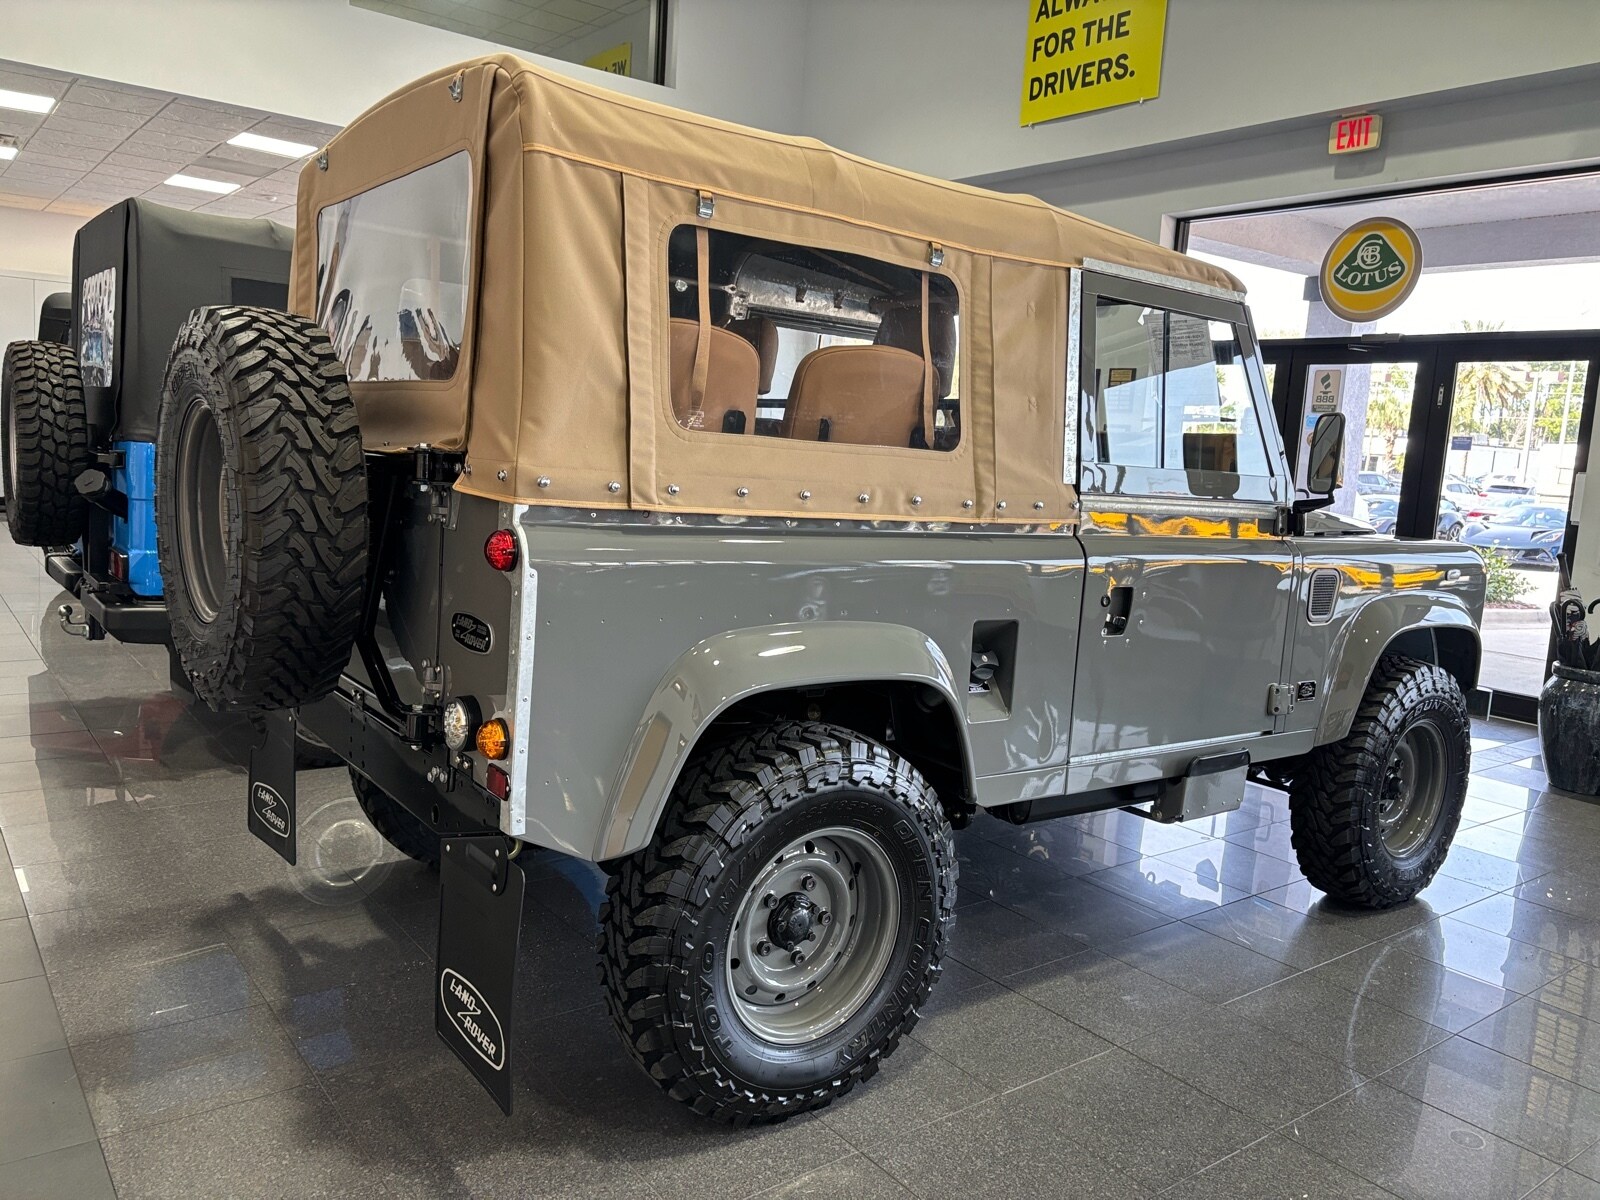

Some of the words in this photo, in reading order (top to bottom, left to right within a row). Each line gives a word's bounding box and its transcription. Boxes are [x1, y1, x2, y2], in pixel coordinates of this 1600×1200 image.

[1032, 27, 1076, 62] FOR
[1083, 10, 1131, 47] THE
[1029, 53, 1135, 101] DRIVERS.
[1336, 116, 1373, 150] EXIT
[1335, 260, 1402, 286] LOTUS
[456, 614, 473, 629] LAND
[464, 633, 487, 650] ROVER
[257, 787, 274, 805] LAND
[265, 809, 286, 831] ROVER
[893, 819, 933, 902] OPEN
[449, 978, 477, 1012] LAND
[699, 941, 734, 1058] TOYO
[830, 916, 931, 1072] COUNTRY
[463, 1015, 497, 1060] ROVER
